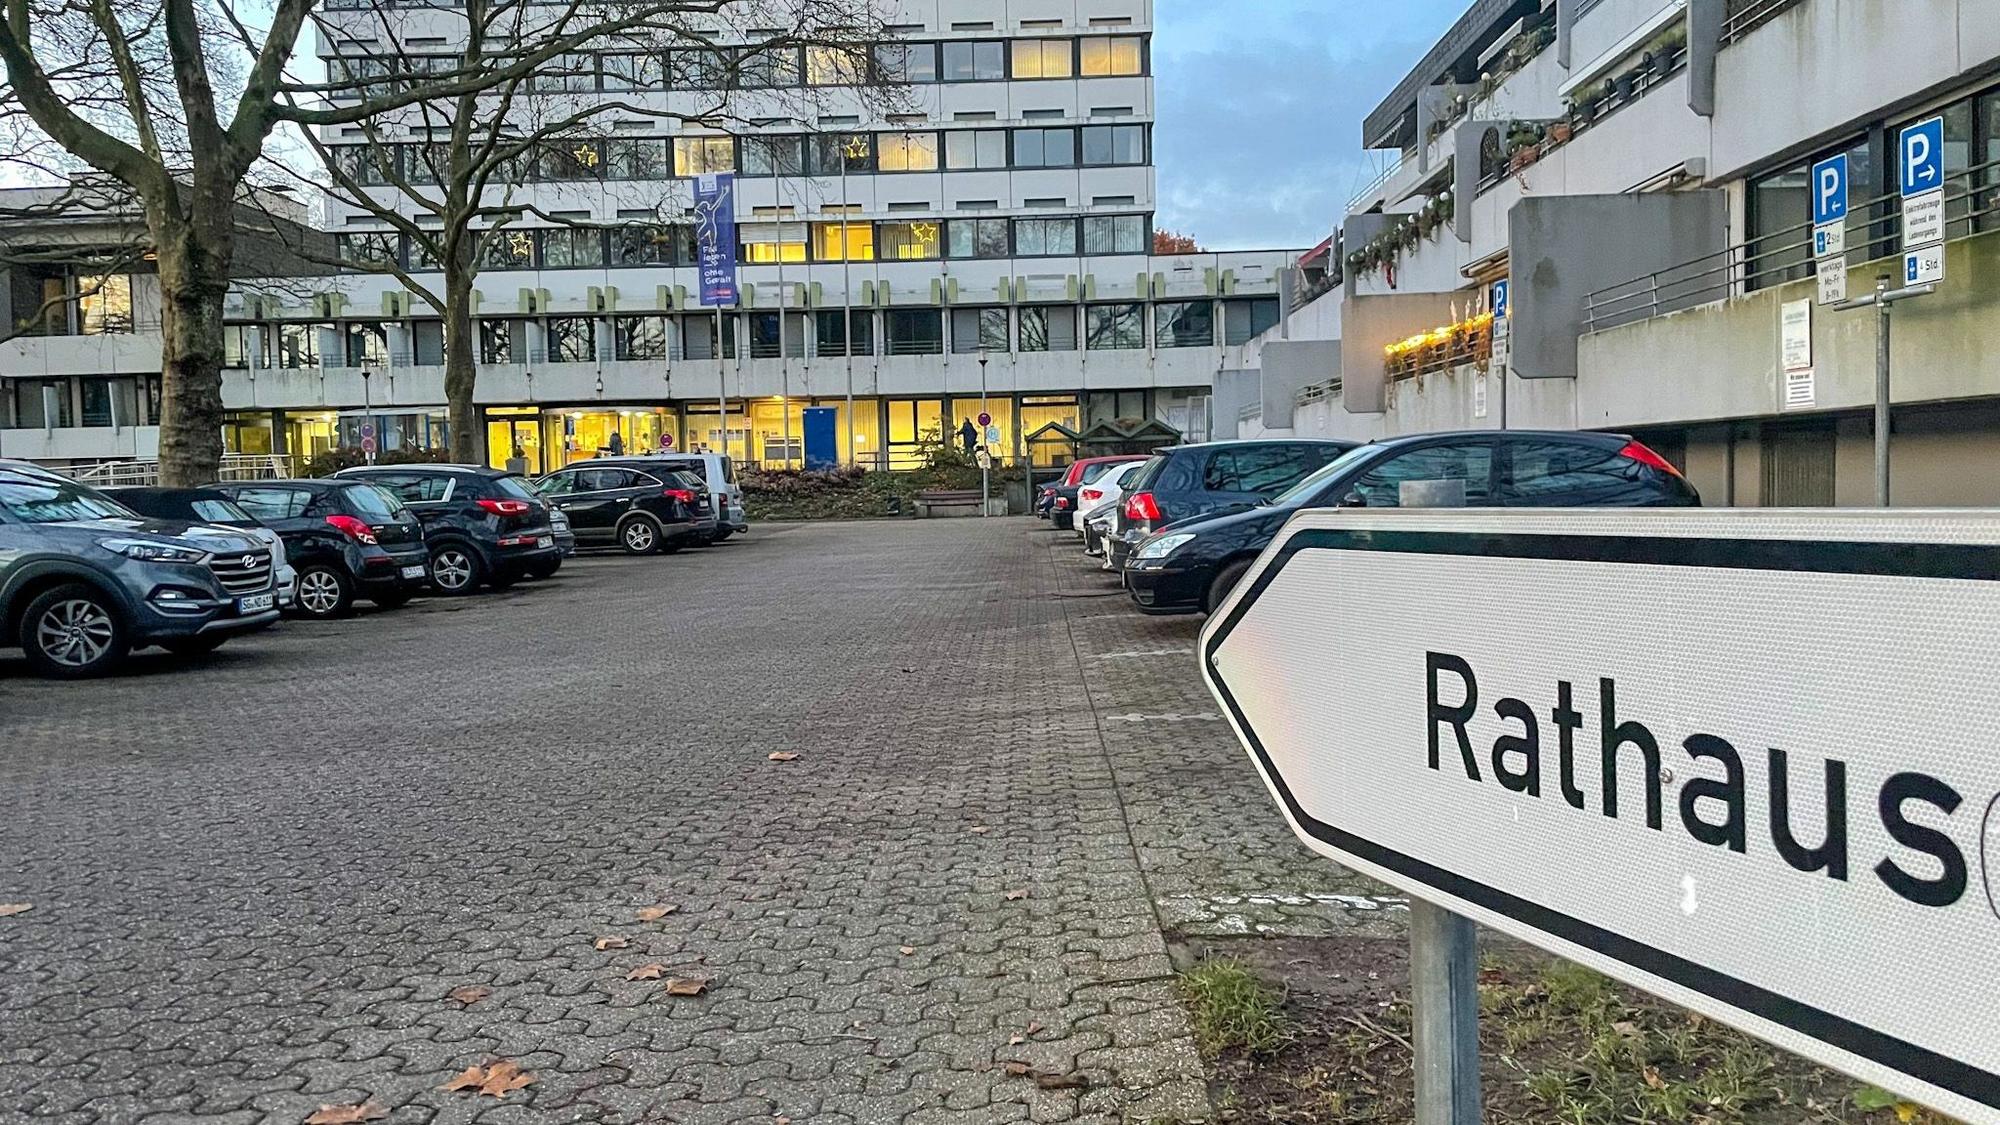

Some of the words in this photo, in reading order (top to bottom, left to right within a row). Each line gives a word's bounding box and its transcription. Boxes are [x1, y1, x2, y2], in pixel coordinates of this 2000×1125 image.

[1907, 133, 1930, 187] P
[1821, 167, 1839, 216] P
[1425, 650, 1969, 908] Rathaus
